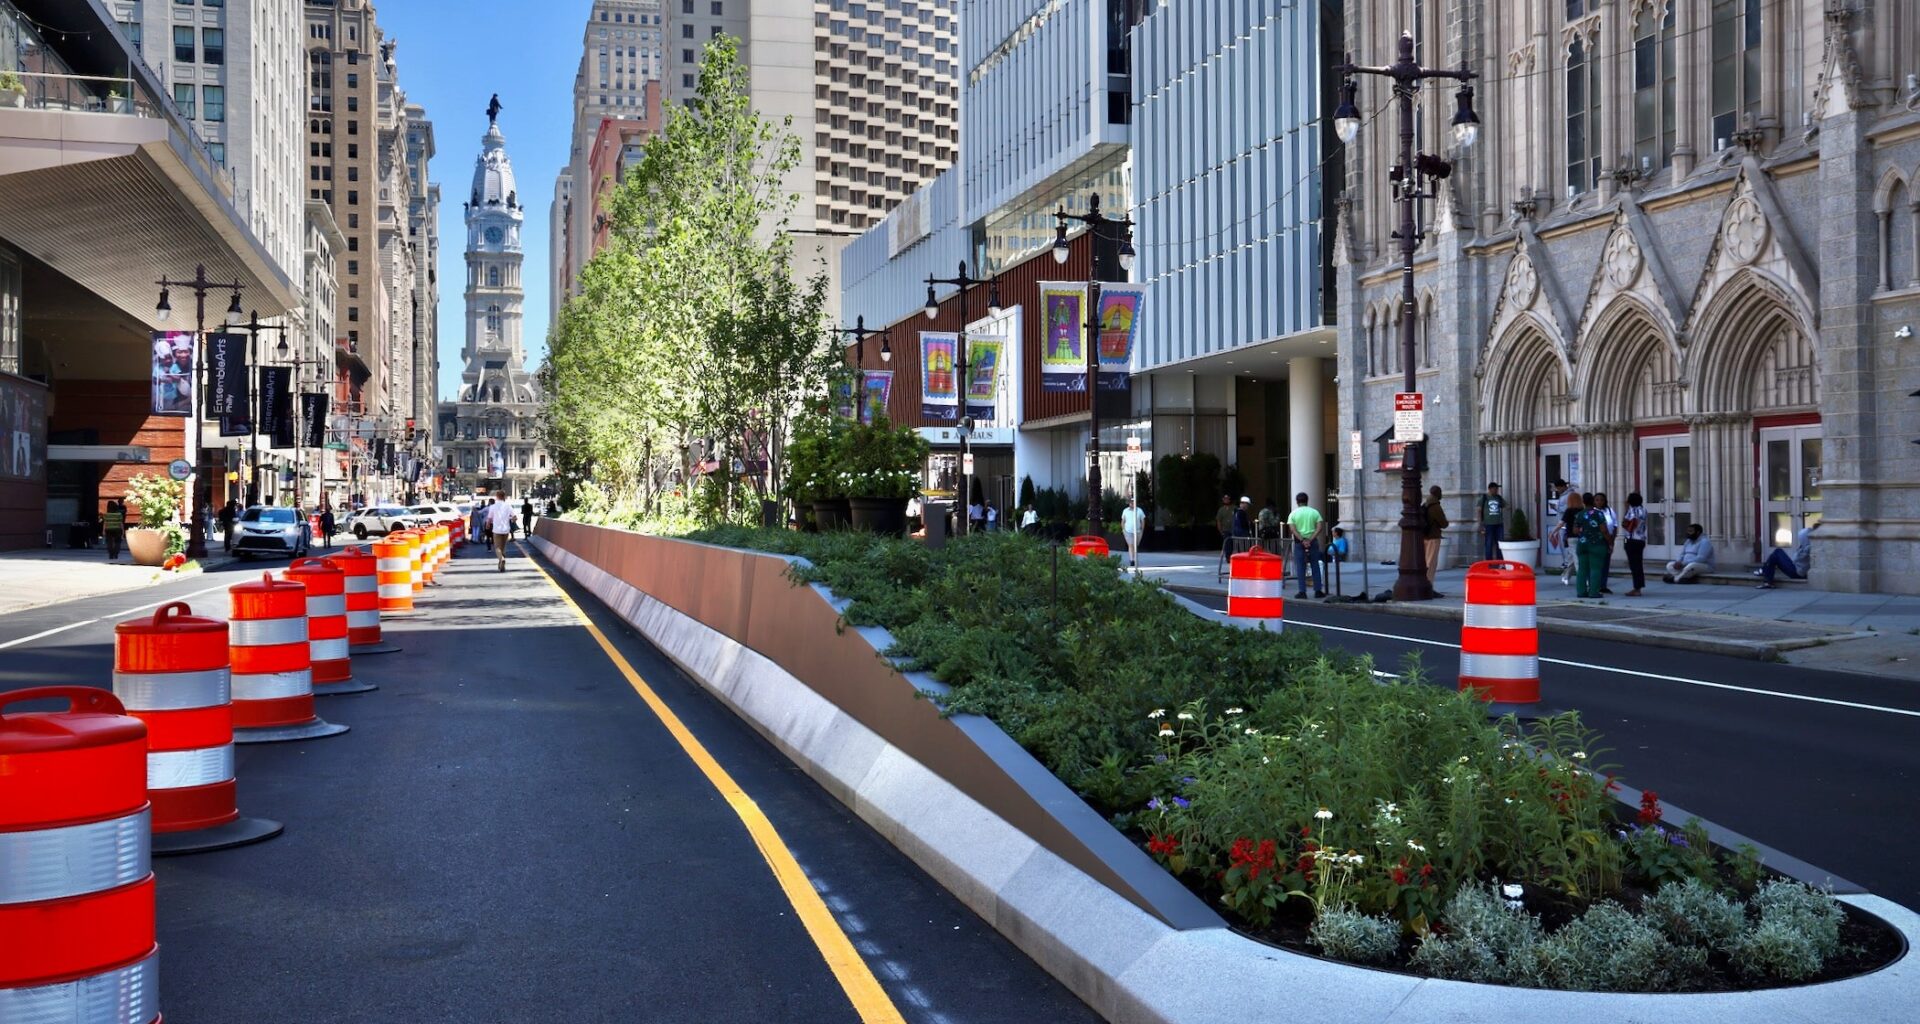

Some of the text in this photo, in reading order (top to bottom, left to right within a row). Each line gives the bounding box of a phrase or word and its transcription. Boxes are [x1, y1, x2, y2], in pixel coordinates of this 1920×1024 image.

[213, 338, 227, 413] EnsembleArts
[226, 394, 235, 413] Philly
[953, 431, 993, 440] AHAUS
